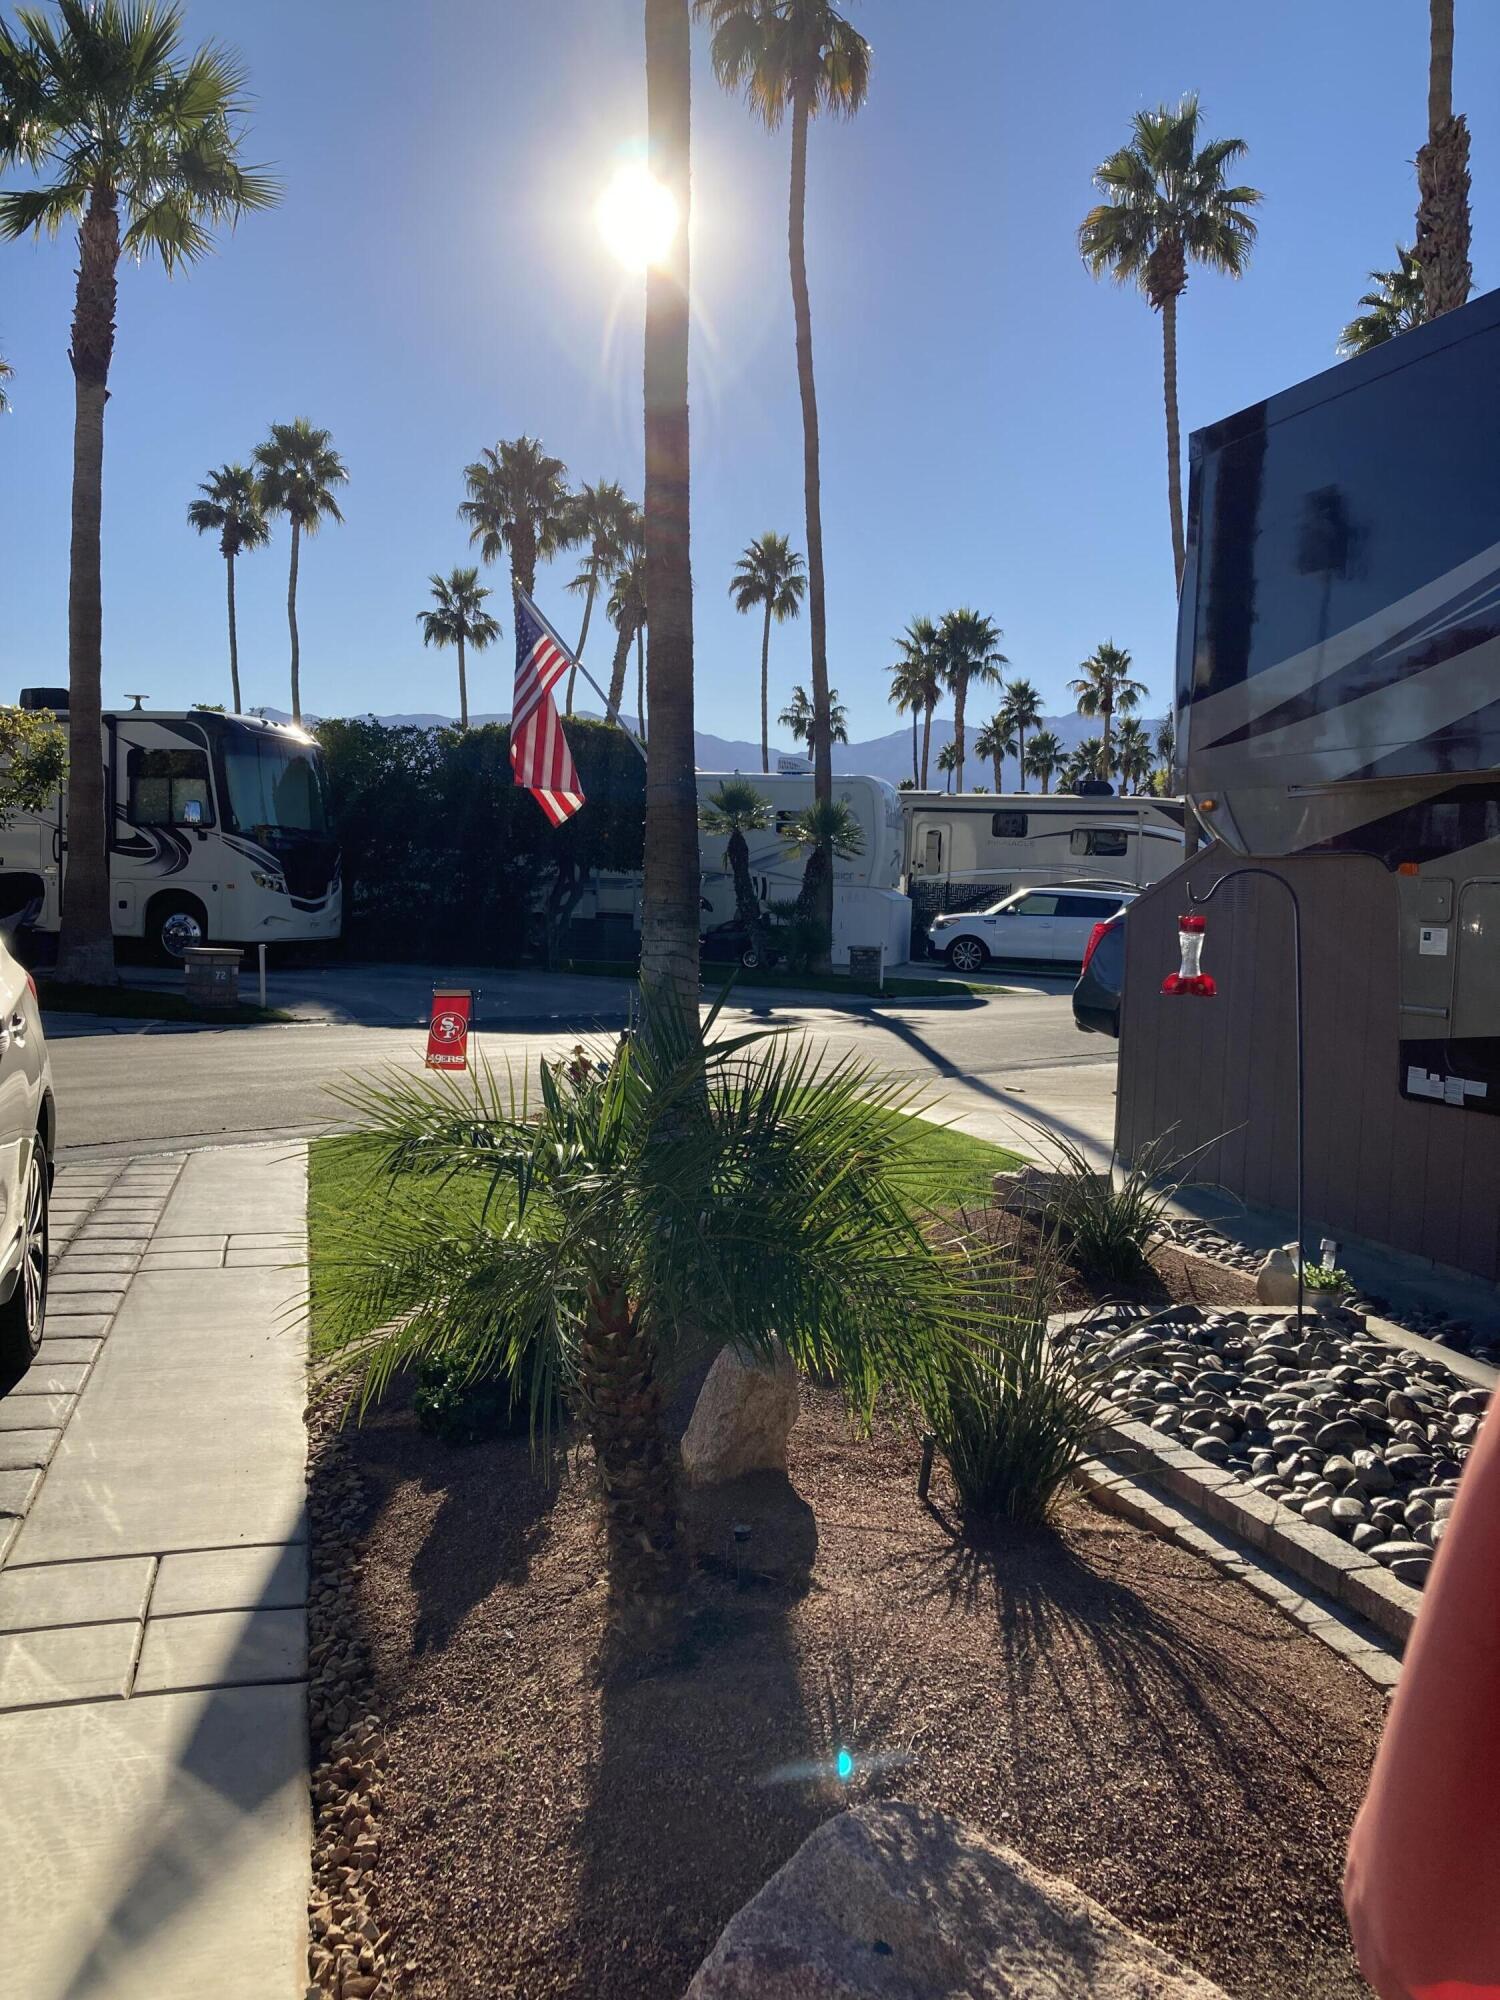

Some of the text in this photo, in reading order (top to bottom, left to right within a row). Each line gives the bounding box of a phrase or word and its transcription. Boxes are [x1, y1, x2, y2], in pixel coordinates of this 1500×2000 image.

[215, 970, 227, 980] 72
[439, 1016, 460, 1039] SF
[428, 1053, 465, 1064] 49ERS
